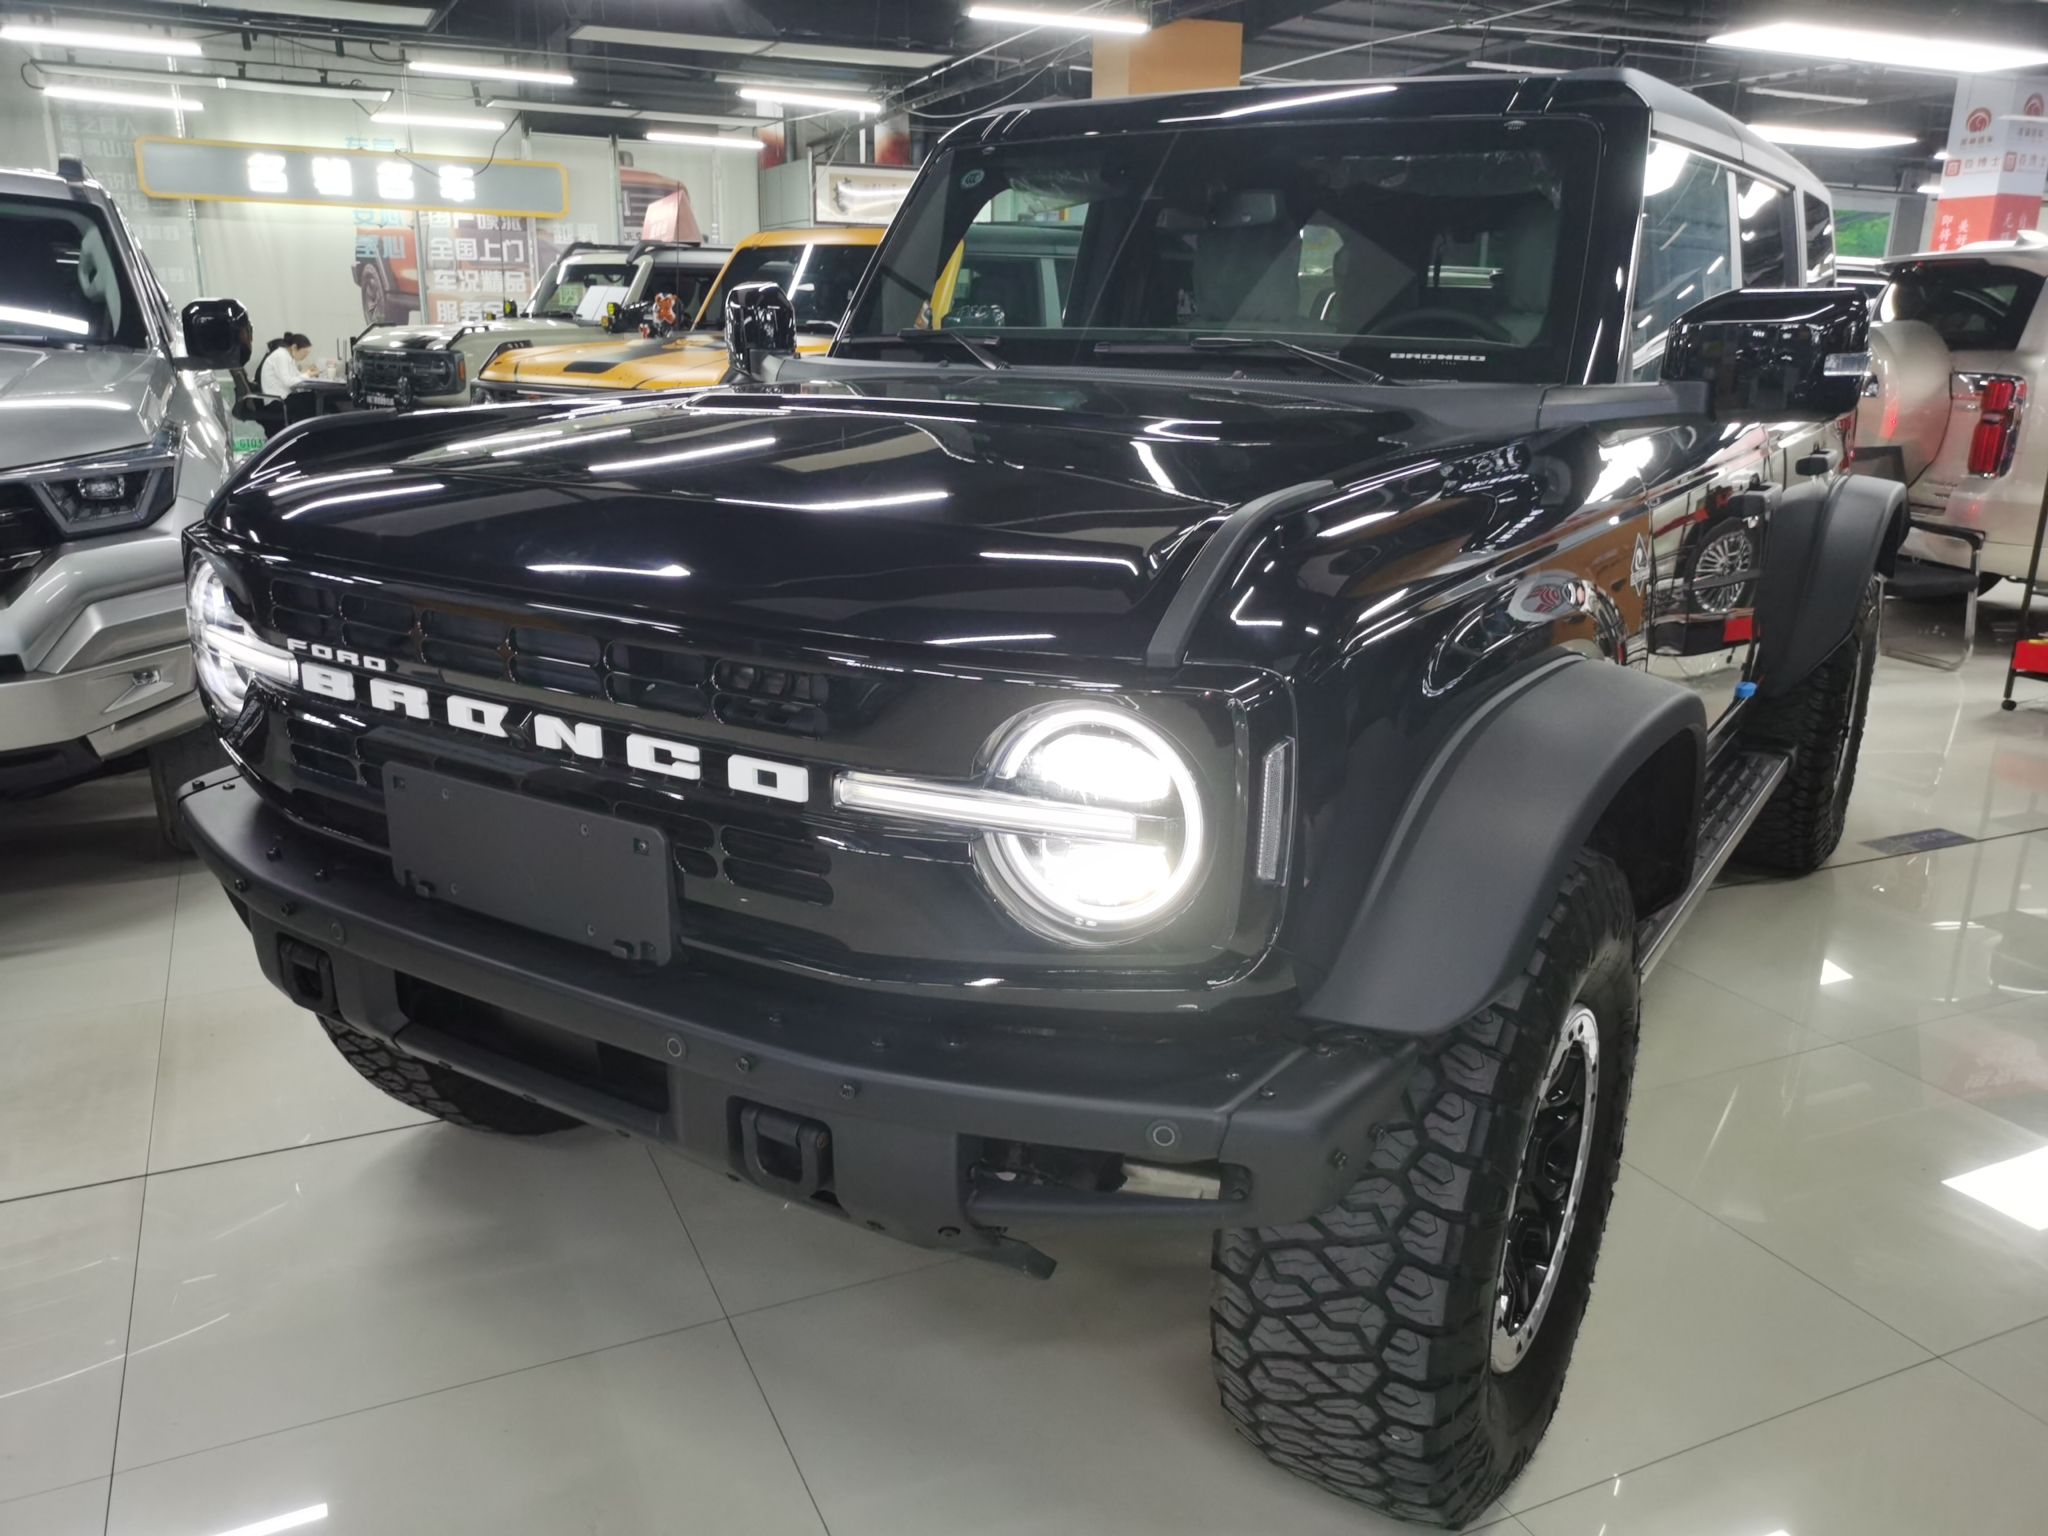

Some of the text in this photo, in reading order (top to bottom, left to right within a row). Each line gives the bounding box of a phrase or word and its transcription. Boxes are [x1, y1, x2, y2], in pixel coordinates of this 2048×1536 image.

[430, 237, 525, 262] 全国上门
[287, 638, 386, 671] FORD
[301, 661, 809, 803] BRONCO
